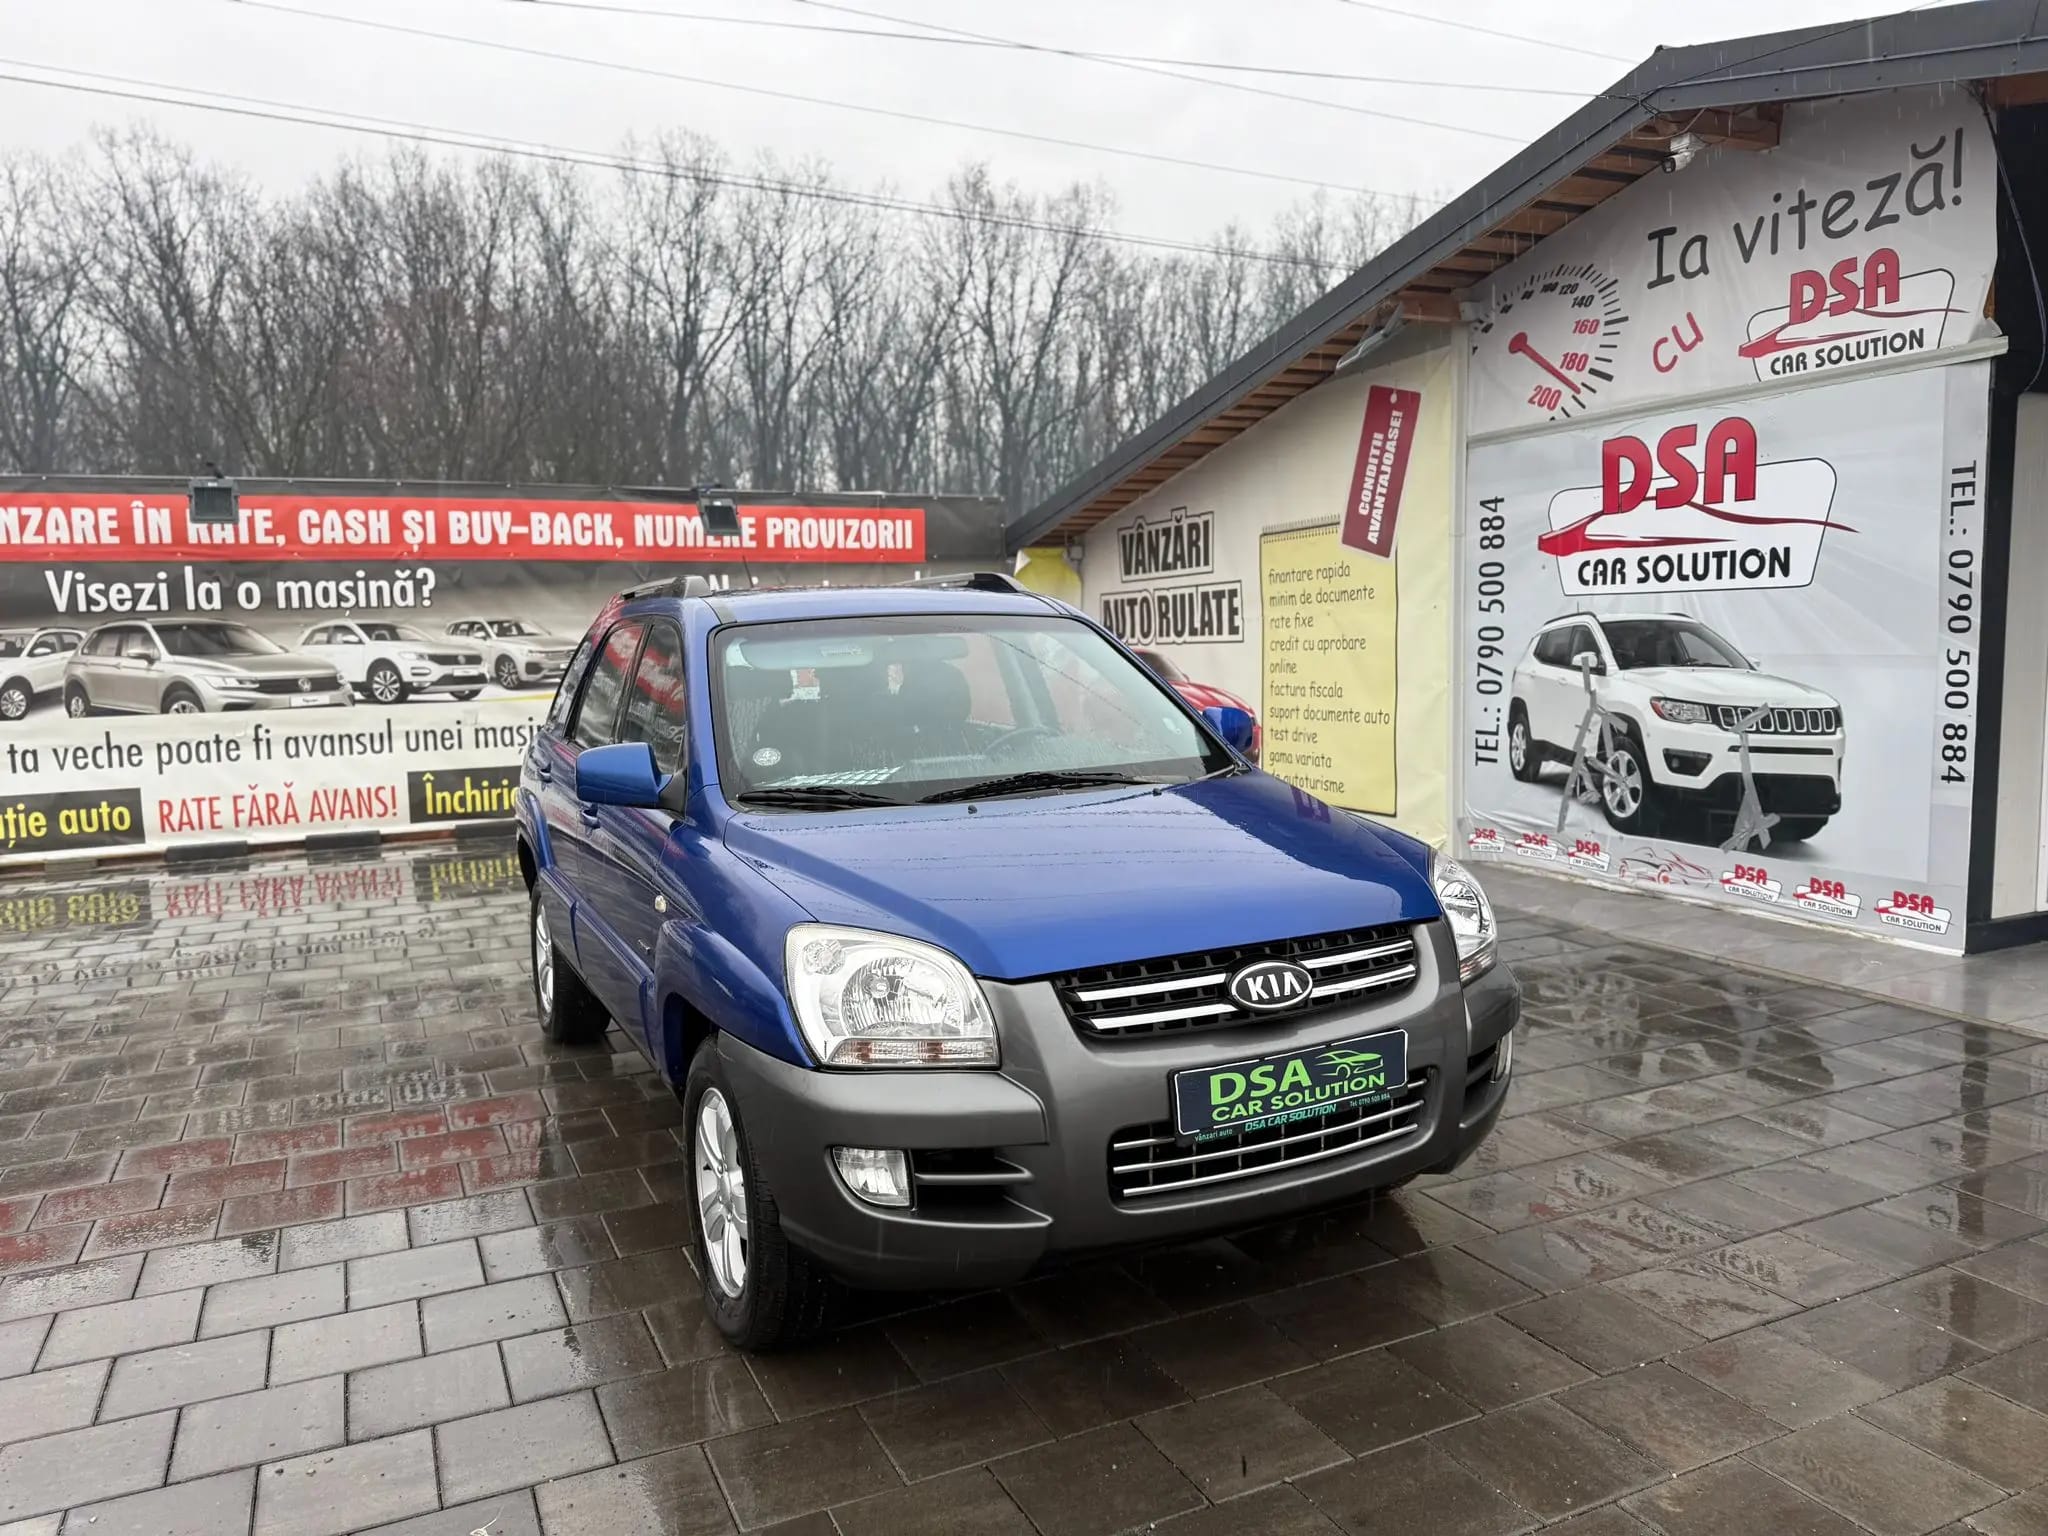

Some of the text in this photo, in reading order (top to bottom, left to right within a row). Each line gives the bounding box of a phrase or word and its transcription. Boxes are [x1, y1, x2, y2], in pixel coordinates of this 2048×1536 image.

[1646, 127, 1965, 290] Ia viteză!
[1559, 282, 1579, 295] 120
[1571, 294, 1595, 308] 140
[1789, 248, 1900, 326] DSA
[1572, 319, 1600, 334] 160
[1652, 312, 1704, 375] cu
[1770, 328, 1925, 376] CAR SOLUTION
[1560, 352, 1589, 372] 180
[1528, 384, 1562, 411] 200
[1367, 410, 1403, 545] AVANTAJOASE!
[1602, 417, 1757, 514] DSA
[130, 500, 172, 544] ÎN
[298, 508, 390, 544] CASH
[402, 509, 436, 552] ȘI
[448, 510, 624, 549] BUY-BACK,
[766, 517, 912, 550] PROVIZORII
[1479, 496, 1505, 551] 884
[1121, 514, 1210, 576] VÂNZĂRI
[1316, 560, 1350, 584] rapida
[1577, 547, 1791, 587] CAR SOLUTION
[44, 565, 436, 617] Visezi la o mașină?
[1269, 584, 1375, 607] minim de documente
[1478, 562, 1505, 614] 500
[1948, 549, 1973, 634] 0790
[1156, 588, 1240, 638] RULATE
[1270, 612, 1313, 629] rate fixe
[1269, 634, 1366, 655] credit cu aprobare
[1269, 657, 1297, 674] online
[1476, 626, 1504, 695] 0790
[1270, 680, 1343, 698] factura fiscala
[1944, 648, 1970, 710] 500
[1269, 704, 1390, 725] suport documente auto
[8, 743, 39, 774] ta
[52, 731, 143, 772] veche
[156, 733, 241, 775] poate
[253, 723, 272, 761] fi
[284, 718, 393, 759] avansul
[405, 720, 463, 752] unei
[1270, 727, 1317, 743] test drive
[1269, 752, 1332, 768] gama variata
[1941, 723, 1967, 784] 884
[59, 801, 131, 835] auto
[159, 782, 398, 833] RATE FĂRĂ AVANS!
[1576, 839, 1600, 856] DSA
[1735, 864, 1767, 885] DSA
[1810, 877, 1845, 899] DSA
[1803, 900, 1853, 916] CAR SOLUTION
[1893, 890, 1934, 914] DSA
[1885, 915, 1941, 932] CAR SOLUTION
[1244, 972, 1301, 1001] KIA
[1210, 1058, 1312, 1106] DSA
[1212, 1072, 1385, 1122] CAR SOLUTION
[1245, 1121, 1266, 1132] DSA
[1267, 1113, 1288, 1127] CAR
[1289, 1103, 1336, 1122] SOLUTION
